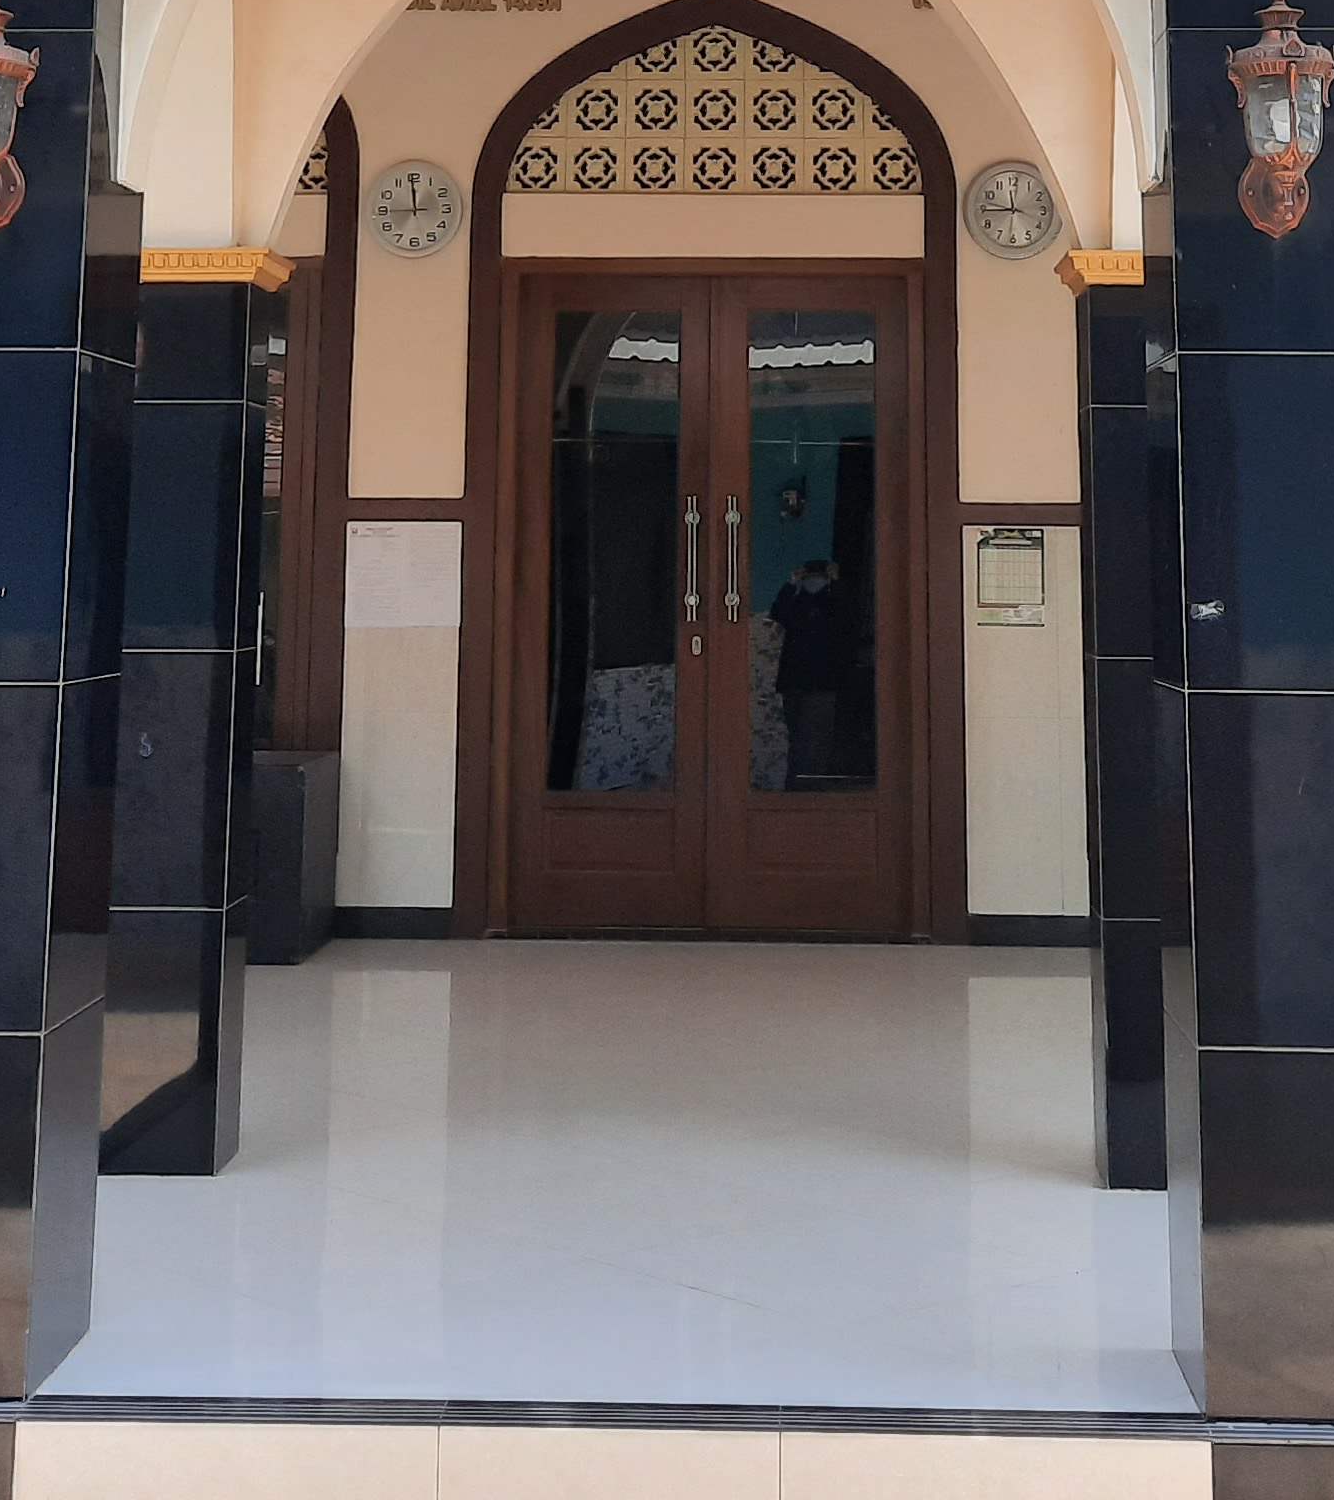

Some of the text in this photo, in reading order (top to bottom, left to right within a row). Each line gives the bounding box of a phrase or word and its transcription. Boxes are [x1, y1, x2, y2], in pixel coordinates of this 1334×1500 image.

[395, 178, 402, 188] 11
[996, 181, 1003, 190] 11
[1008, 177, 1019, 186] 12
[381, 190, 392, 199] 10
[438, 188, 448, 197] 2
[985, 191, 995, 200] 10
[1036, 192, 1043, 201] 2
[378, 206, 388, 215] 9
[442, 204, 451, 213] 3
[1040, 206, 1046, 216] 3
[382, 222, 392, 231] 8
[984, 219, 991, 229] 8
[393, 234, 404, 243] 7
[427, 232, 436, 241] 5
[997, 230, 1003, 239] 7
[1010, 234, 1016, 244] 6
[1025, 231, 1032, 240] 5
[409, 237, 420, 247] 6
